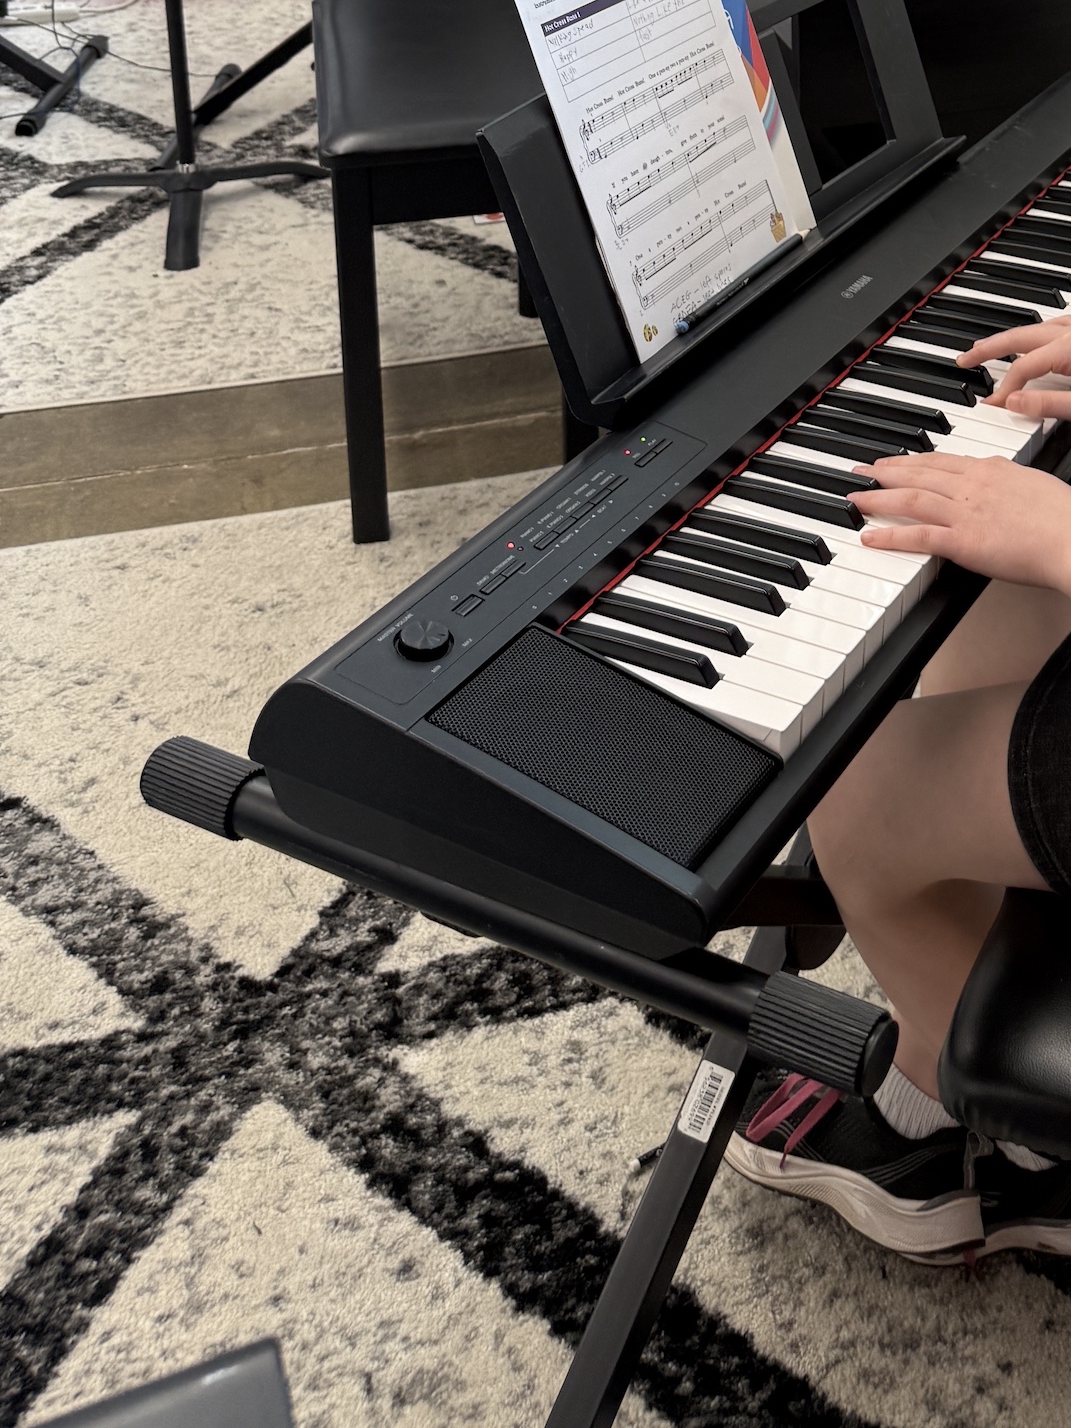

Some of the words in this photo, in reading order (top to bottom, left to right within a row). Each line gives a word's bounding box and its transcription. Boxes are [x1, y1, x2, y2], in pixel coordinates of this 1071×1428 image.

[544, 23, 553, 32] Hot
[553, 18, 566, 29] Cross
[566, 14, 577, 24] Buns
[846, 275, 873, 294] YAMAHA
